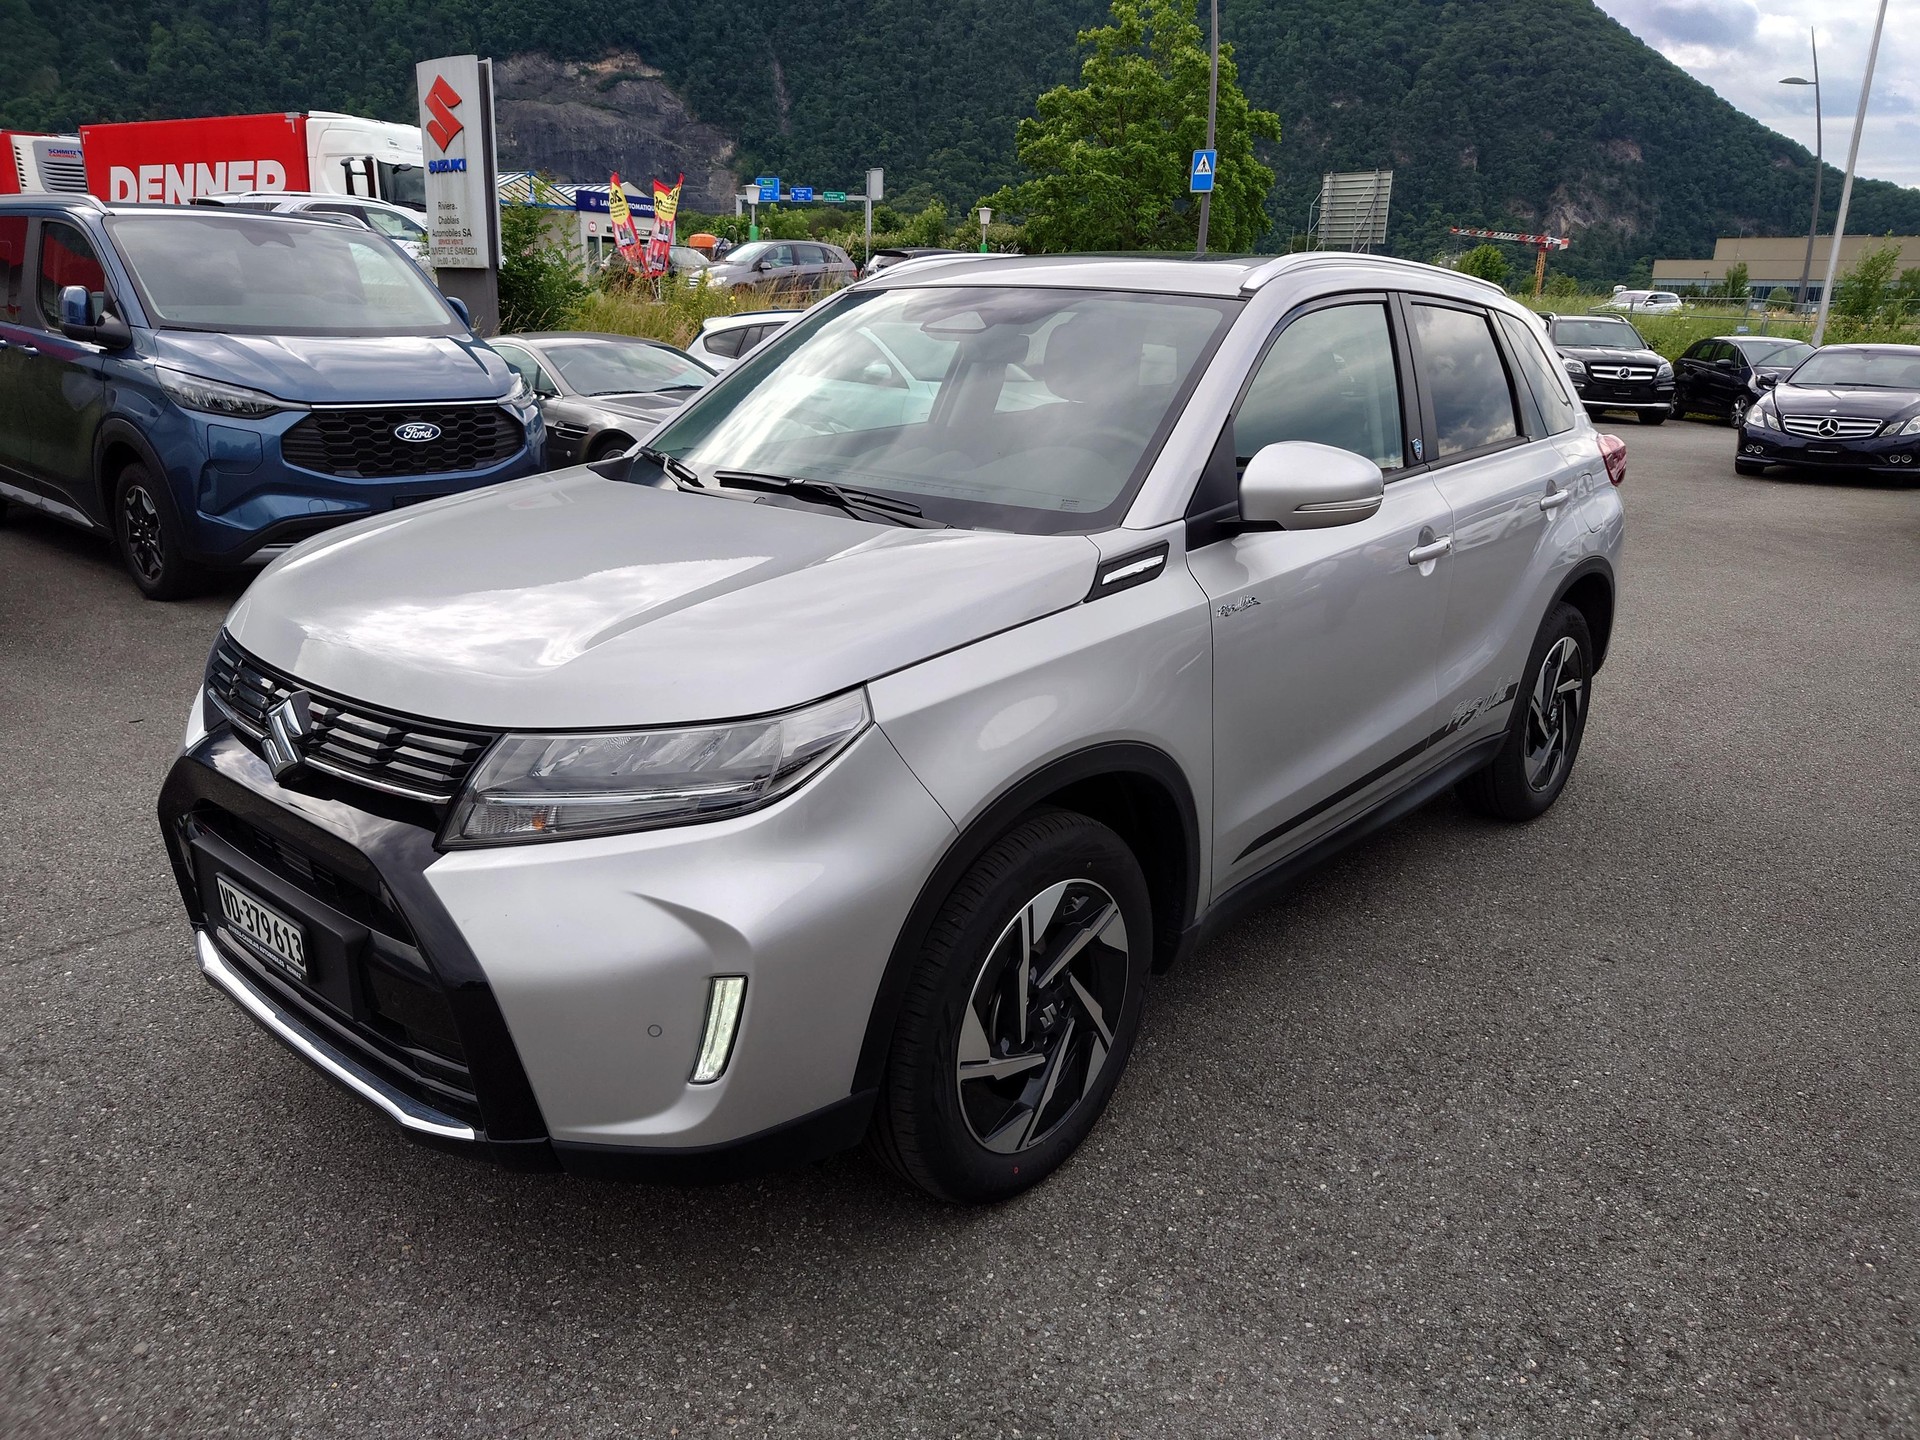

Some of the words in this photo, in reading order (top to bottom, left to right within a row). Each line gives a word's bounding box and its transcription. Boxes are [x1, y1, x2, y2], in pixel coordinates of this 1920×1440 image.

[428, 158, 467, 174] SUZUKI
[110, 159, 287, 205] DENNER
[438, 214, 460, 225] Chablais
[432, 229, 461, 238] Automobiles
[462, 228, 472, 238] SA
[455, 246, 478, 256] SAMEDI
[403, 425, 433, 439] Ford
